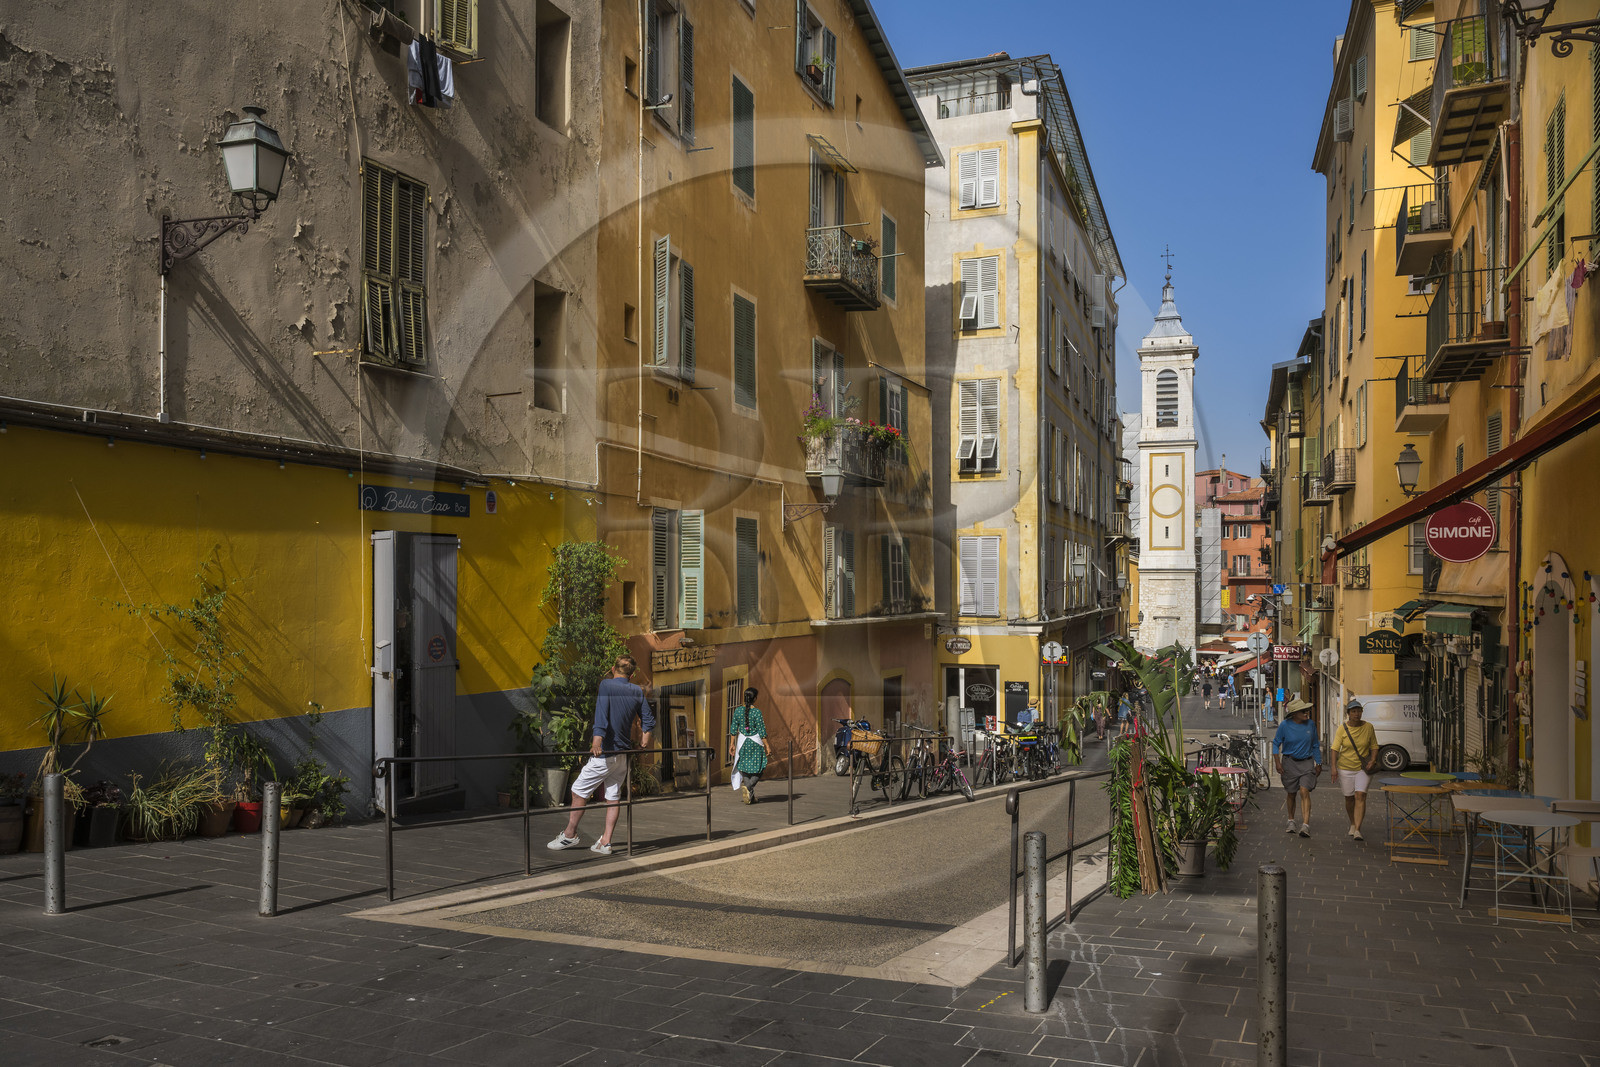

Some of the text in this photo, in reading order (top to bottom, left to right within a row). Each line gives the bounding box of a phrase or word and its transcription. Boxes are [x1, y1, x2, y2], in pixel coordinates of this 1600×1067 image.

[381, 490, 418, 511] Bella
[421, 494, 451, 514] Ciao
[454, 502, 467, 513] Bar
[1468, 515, 1482, 526] Café
[1429, 526, 1491, 538] SIMONE
